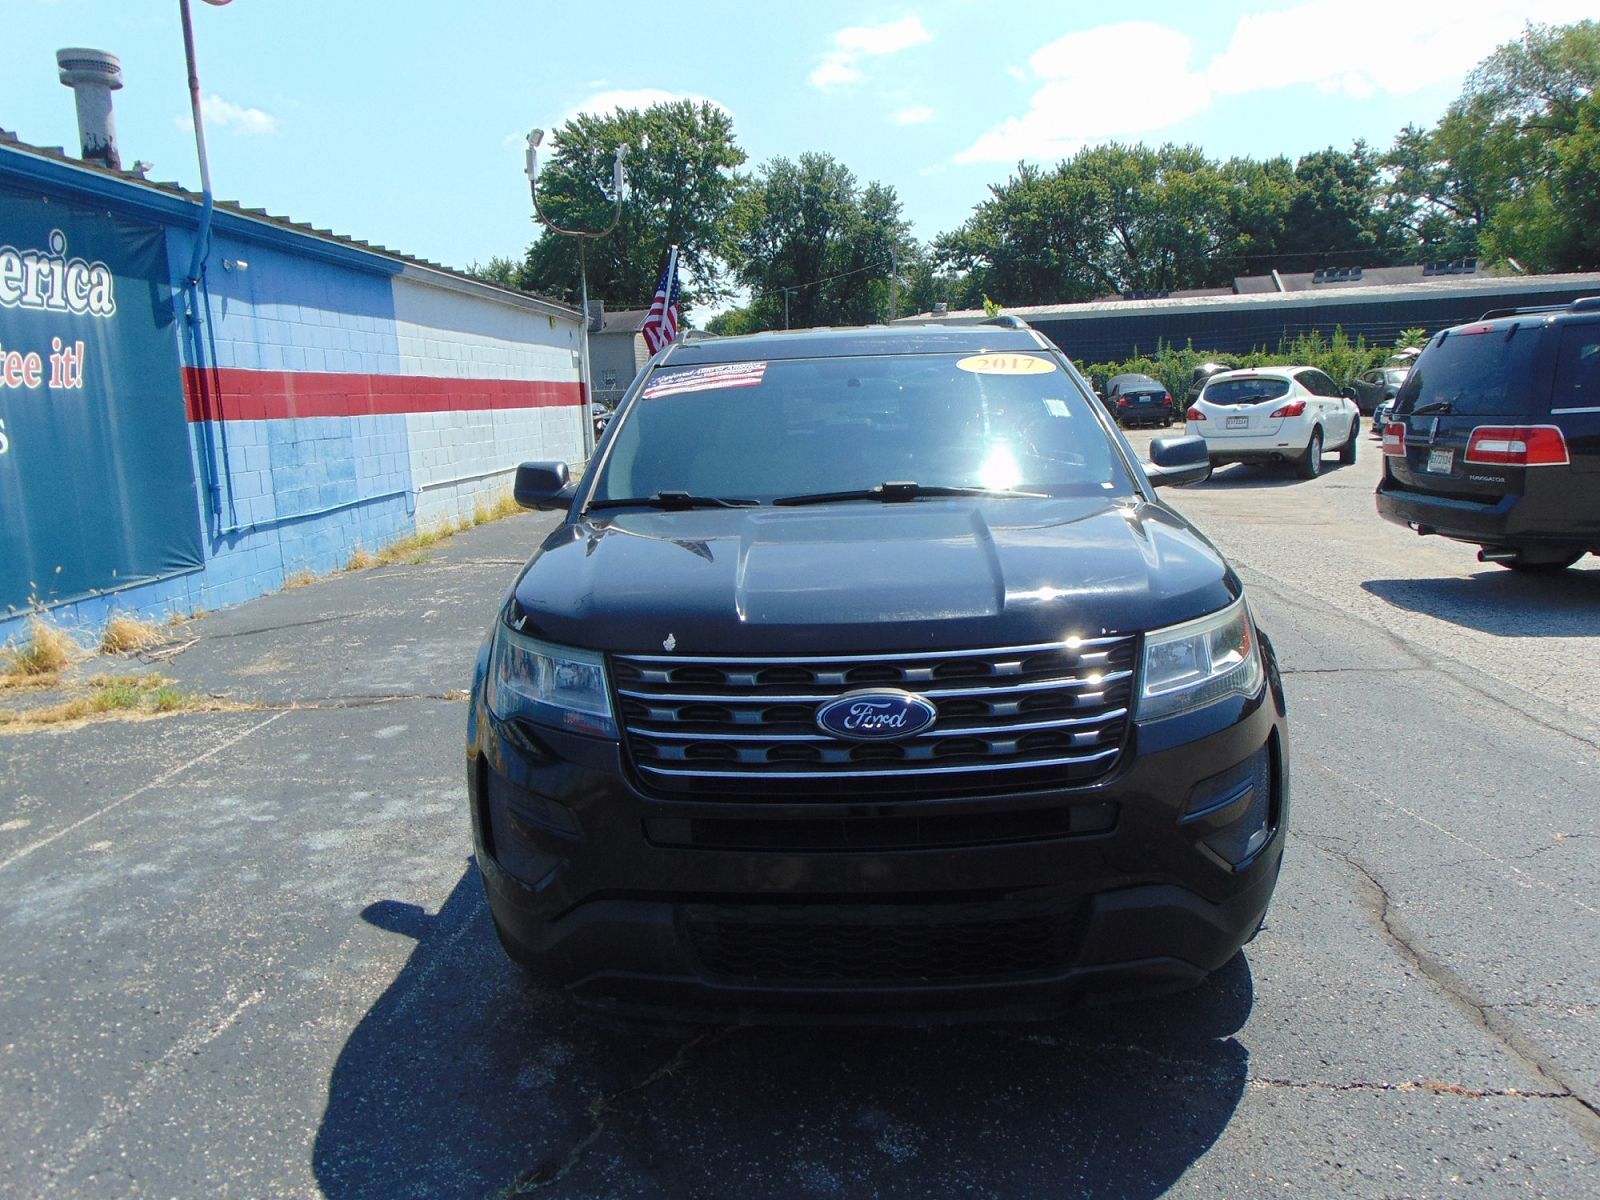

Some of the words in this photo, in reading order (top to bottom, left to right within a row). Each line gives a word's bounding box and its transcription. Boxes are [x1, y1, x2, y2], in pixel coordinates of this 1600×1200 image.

[49, 336, 84, 389] it!
[977, 358, 1036, 371] 2017
[843, 702, 907, 729] Ford
